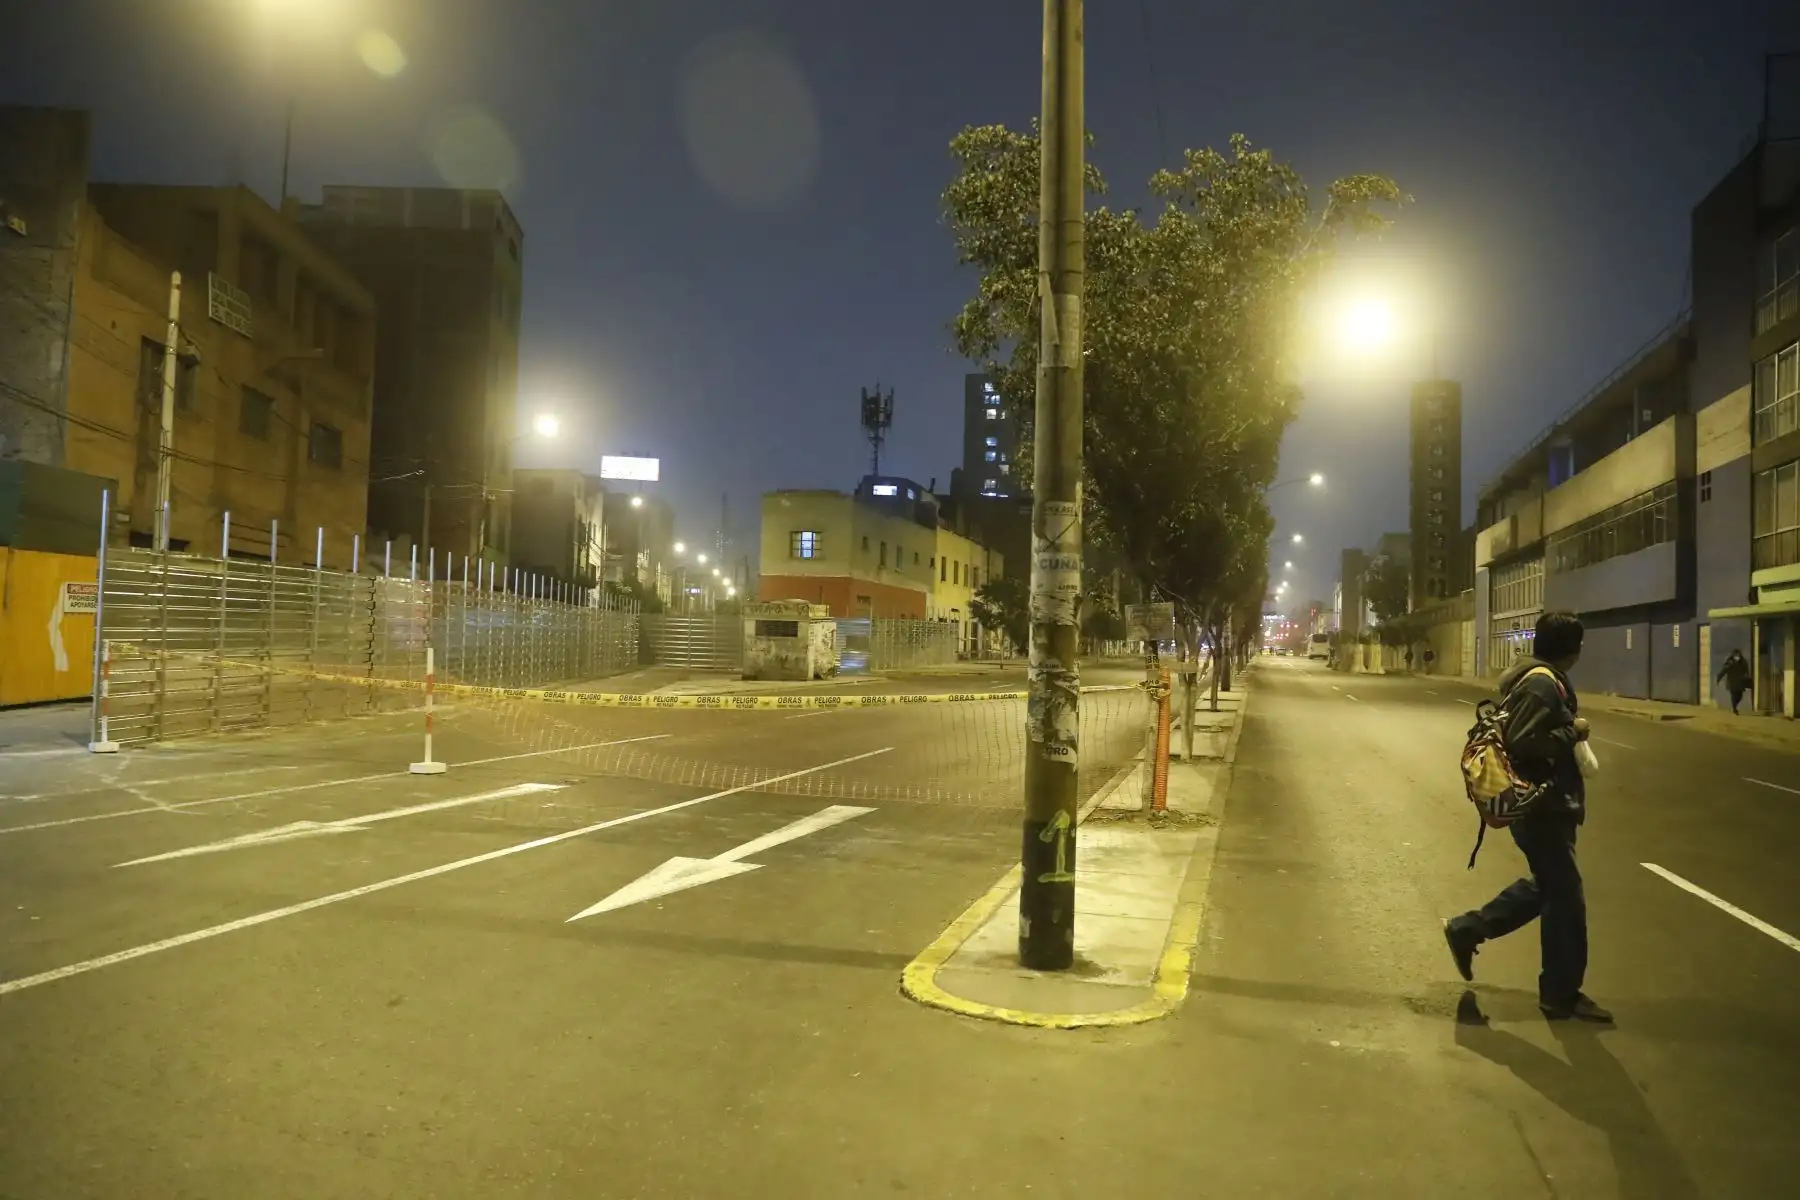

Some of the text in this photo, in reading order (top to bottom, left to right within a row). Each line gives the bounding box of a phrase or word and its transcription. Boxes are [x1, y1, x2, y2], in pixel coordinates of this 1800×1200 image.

[503, 688, 527, 697] PELIGRO
[543, 691, 567, 699] OBRAS
[576, 693, 601, 701] PELIGRO
[618, 694, 642, 702] OBRAS
[653, 695, 679, 703] PELIGRO
[696, 696, 721, 704] OBRAS
[732, 696, 758, 704] PELIGRO
[777, 696, 802, 704] OBRAS
[814, 696, 841, 704] PELIGRO
[861, 696, 887, 704] OBRAS
[899, 695, 928, 703] PELIGRO
[948, 694, 976, 702] OBRAS
